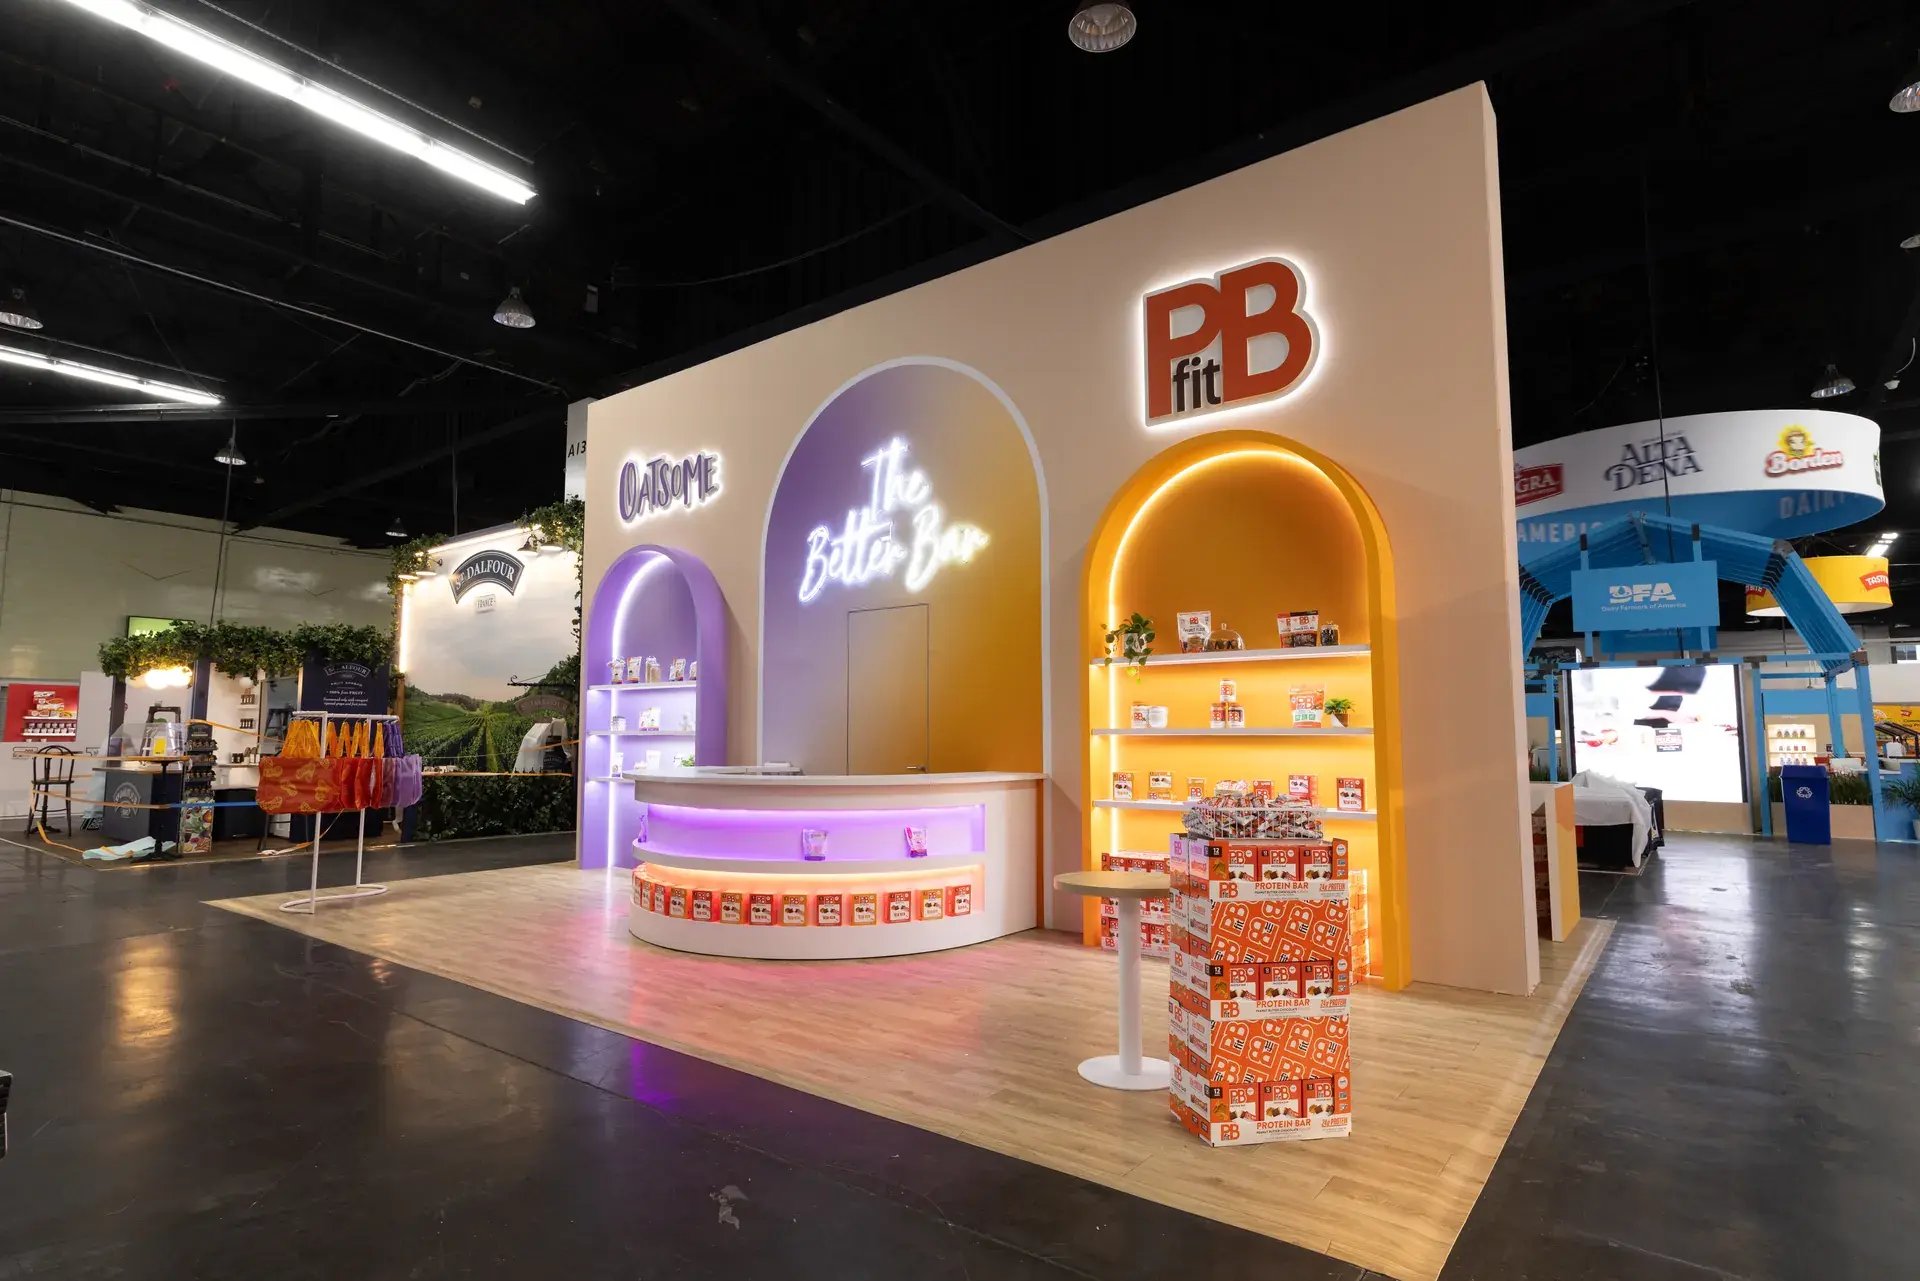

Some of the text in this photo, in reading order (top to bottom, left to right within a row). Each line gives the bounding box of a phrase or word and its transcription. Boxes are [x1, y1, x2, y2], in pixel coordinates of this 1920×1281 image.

[1147, 261, 1312, 418] PB
[1173, 356, 1221, 413] fit
[1622, 436, 1696, 465] ALTA
[1766, 448, 1843, 477] Borden
[861, 437, 930, 523] The
[1604, 455, 1703, 491] DENA
[619, 454, 719, 521] OATSOME
[799, 504, 992, 602] Better Bar
[467, 559, 515, 582] DALFOUR
[1609, 582, 1677, 604] DFA
[1658, 601, 1687, 609] America
[1229, 850, 1245, 864] PB
[1270, 850, 1287, 864] PB
[1312, 850, 1328, 864] PB
[1219, 882, 1238, 898] PB
[1255, 882, 1291, 890] PROTEIN
[1231, 969, 1246, 983] PB
[1273, 967, 1288, 981] PB
[1314, 966, 1330, 980] PB
[1220, 1001, 1240, 1018] PB
[1256, 999, 1310, 1008] PROTEIN BAR
[1230, 1089, 1246, 1104] PB
[1274, 1086, 1289, 1100] PB
[1316, 1084, 1332, 1098] PB
[1256, 1119, 1311, 1130] PROTEIN BAR
[1220, 1124, 1240, 1141] PB
